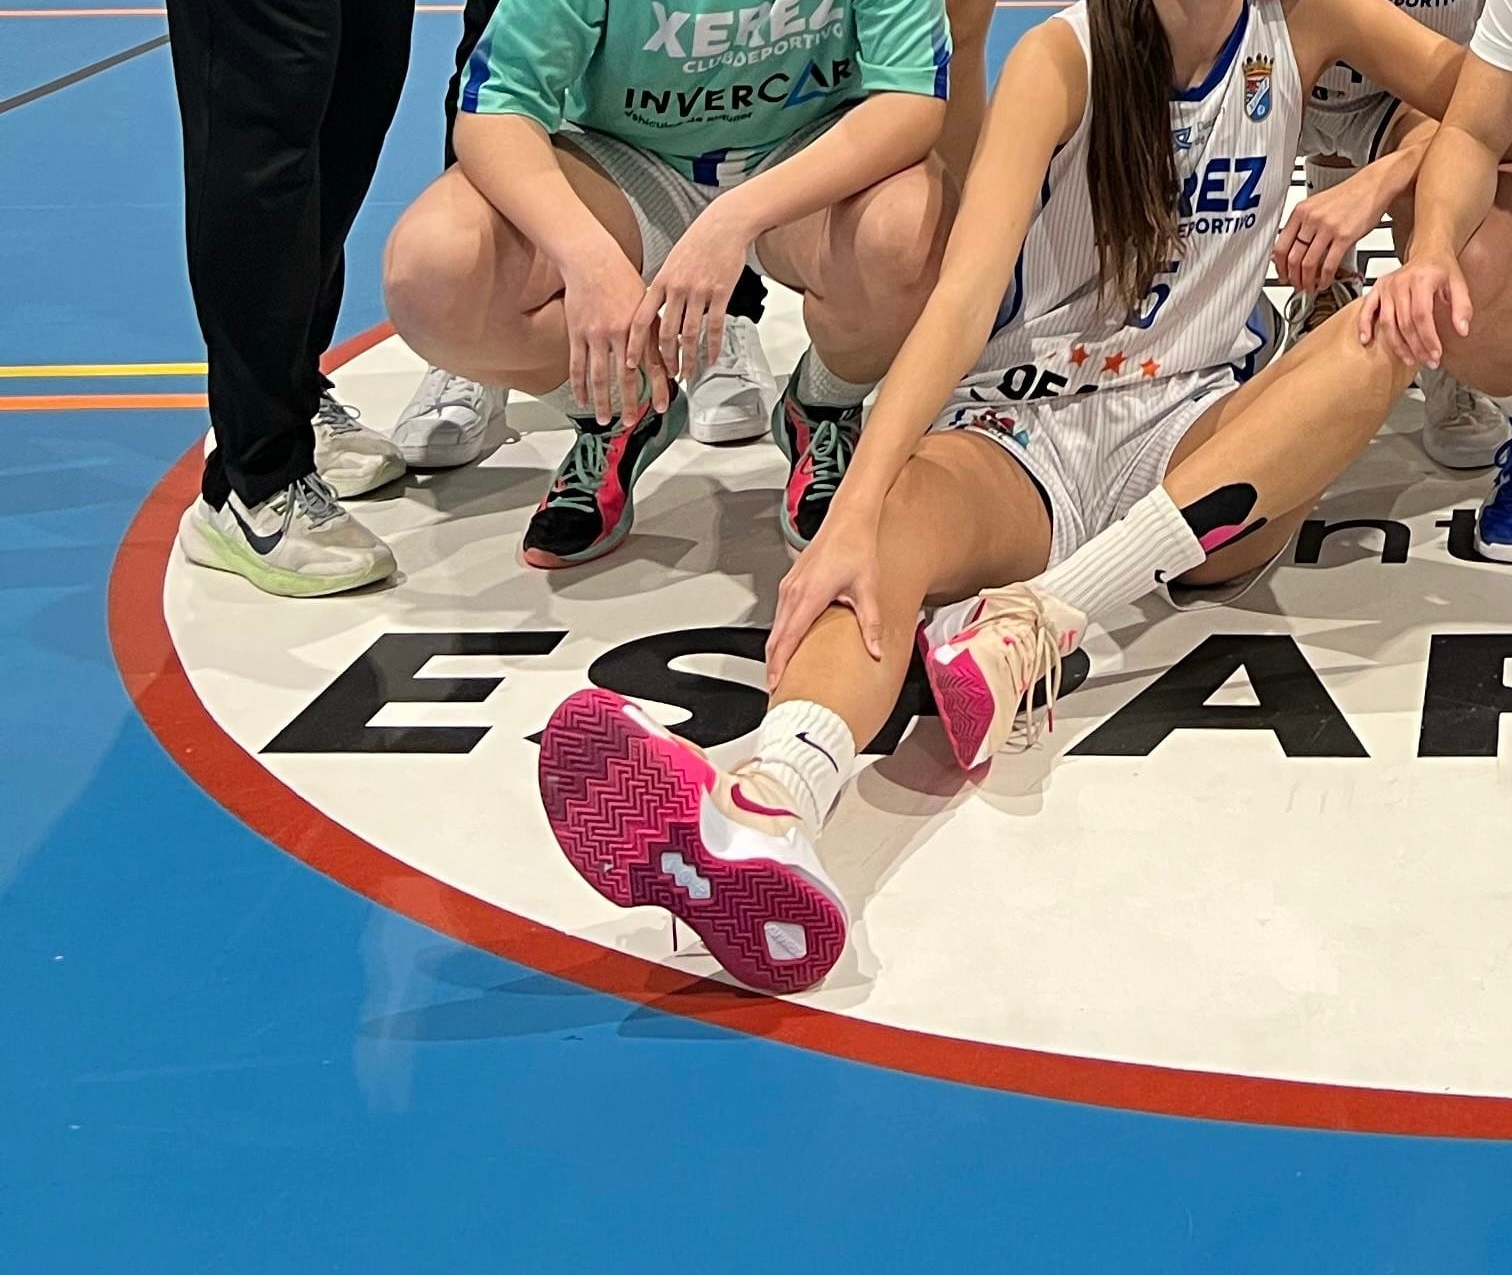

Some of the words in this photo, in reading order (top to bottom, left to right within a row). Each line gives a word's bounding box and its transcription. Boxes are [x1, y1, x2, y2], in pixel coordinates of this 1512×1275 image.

[682, 51, 734, 74] CLUB
[730, 25, 844, 68] DEPORTIVO
[624, 58, 854, 118] INVERCAR
[1178, 155, 1268, 217] REZ
[1178, 212, 1256, 238] EPORTIVO
